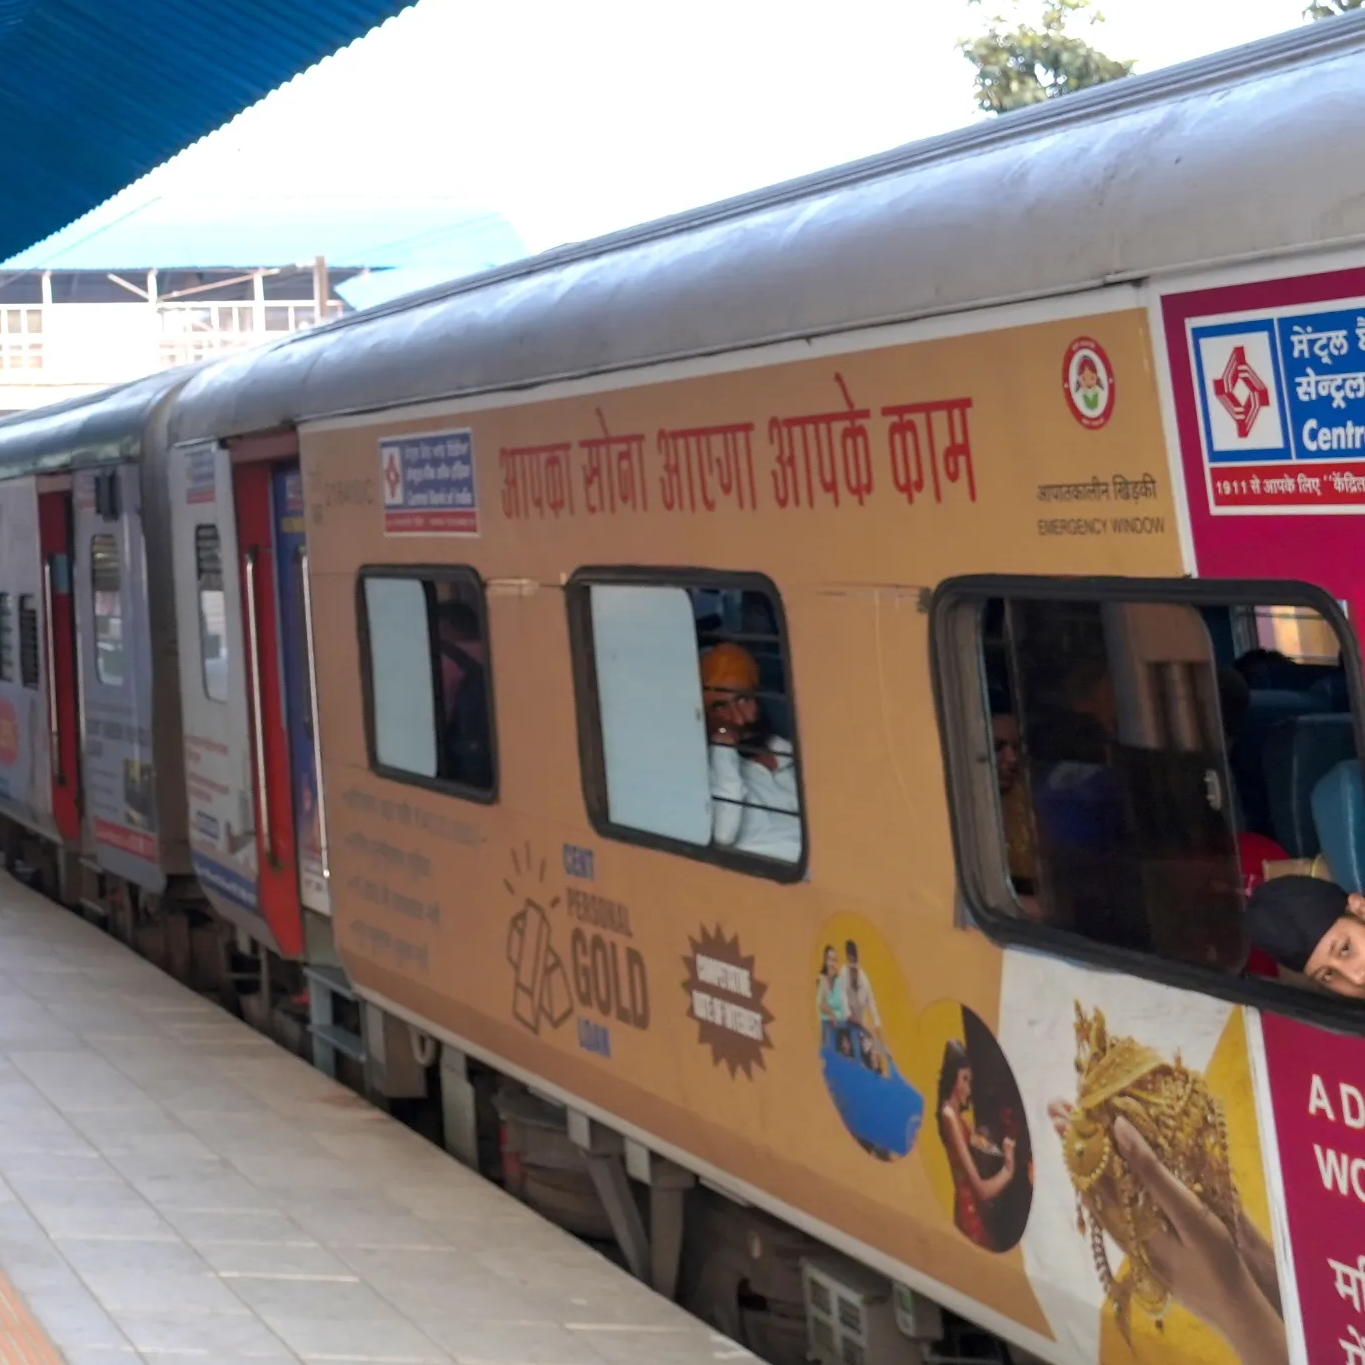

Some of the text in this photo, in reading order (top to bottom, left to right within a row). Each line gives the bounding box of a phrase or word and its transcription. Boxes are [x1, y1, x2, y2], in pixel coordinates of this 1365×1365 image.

[498, 371, 977, 520] आपका सोना आएगा आपके काम
[1216, 479, 1248, 495] 1911
[1262, 472, 1296, 495] आपके
[1297, 472, 1322, 497] लिए
[1037, 516, 1165, 535] EMERGENCY WINDOW
[571, 926, 650, 1031] GOLD
[1308, 1073, 1336, 1122] A
